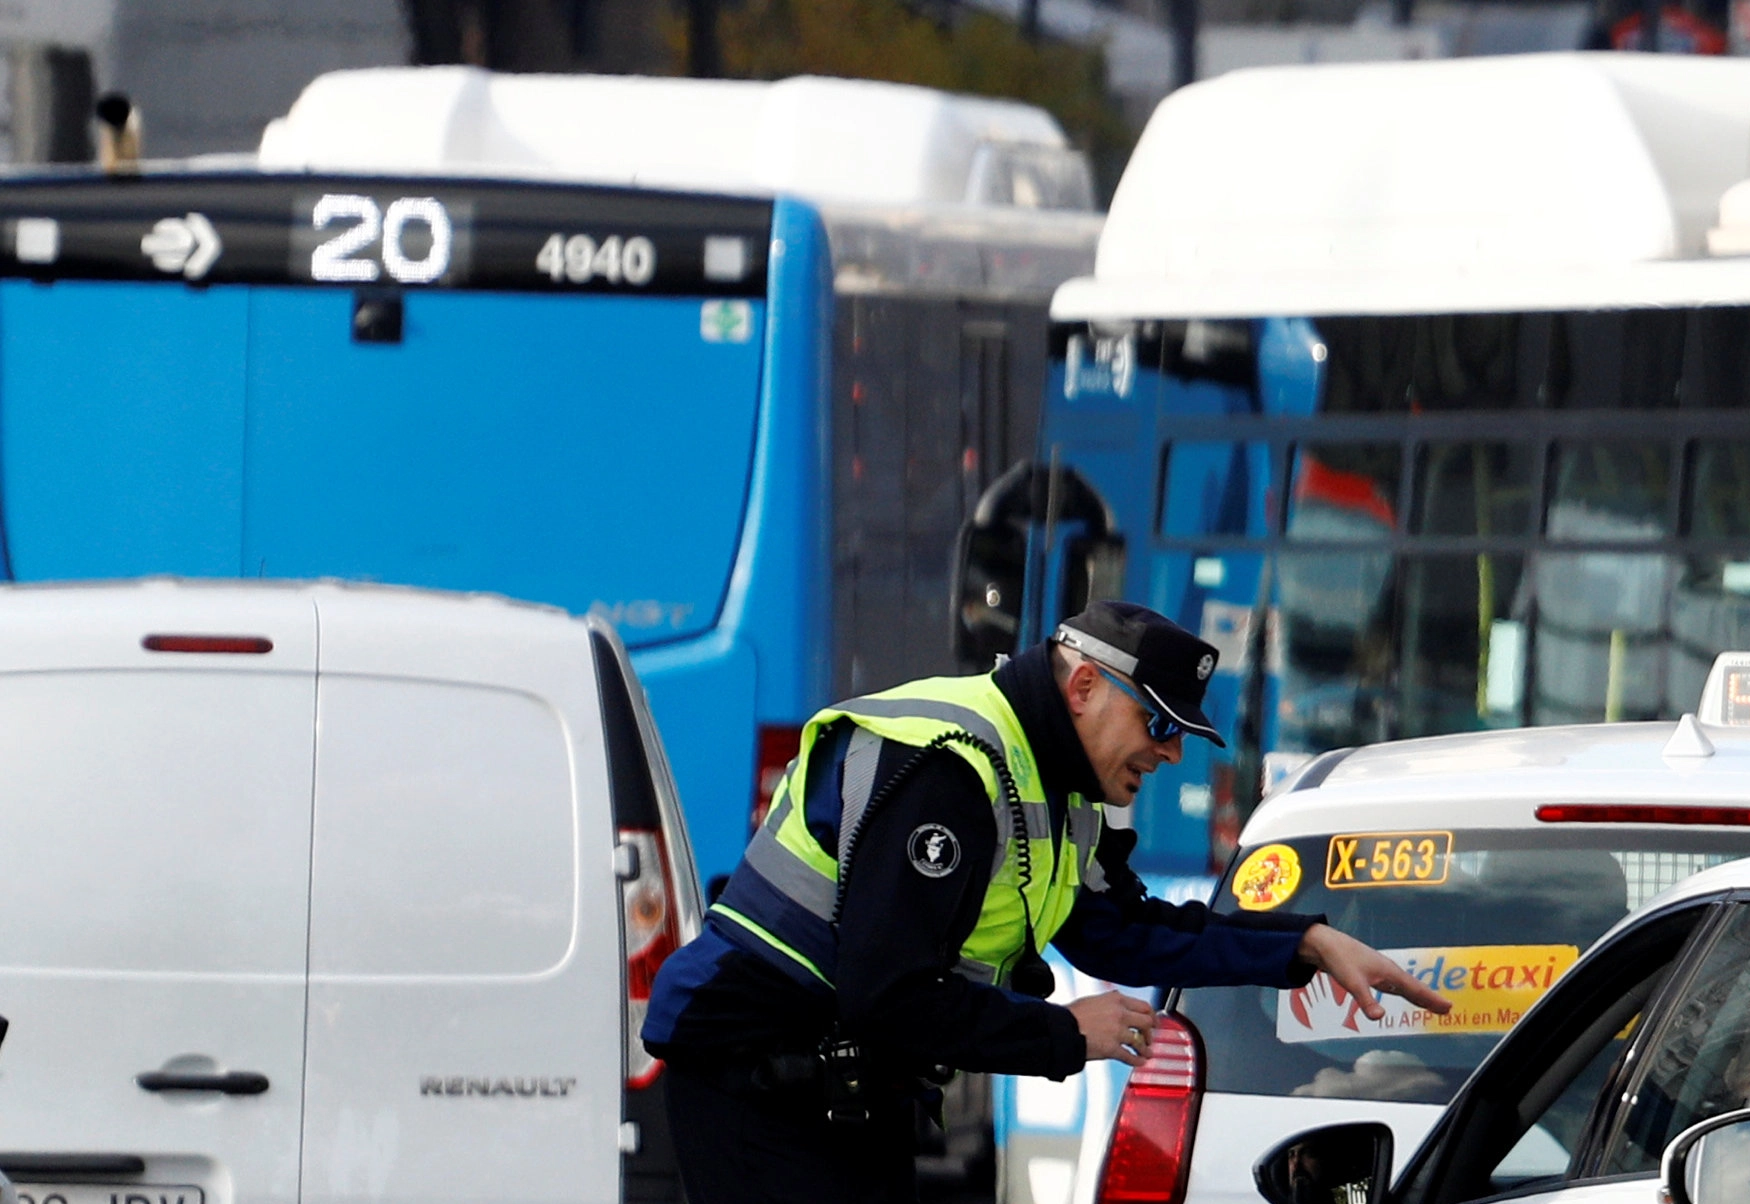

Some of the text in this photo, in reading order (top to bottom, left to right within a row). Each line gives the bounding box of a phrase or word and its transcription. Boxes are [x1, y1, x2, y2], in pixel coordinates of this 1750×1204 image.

[311, 194, 452, 283] 20
[536, 233, 656, 285] 4940
[1331, 838, 1435, 881] X-563
[1380, 956, 1556, 996] idetaxi
[1399, 1009, 1433, 1027] APP
[1472, 1012, 1491, 1026] en
[1497, 1008, 1524, 1025] Ma
[420, 1075, 577, 1097] RENAULT
